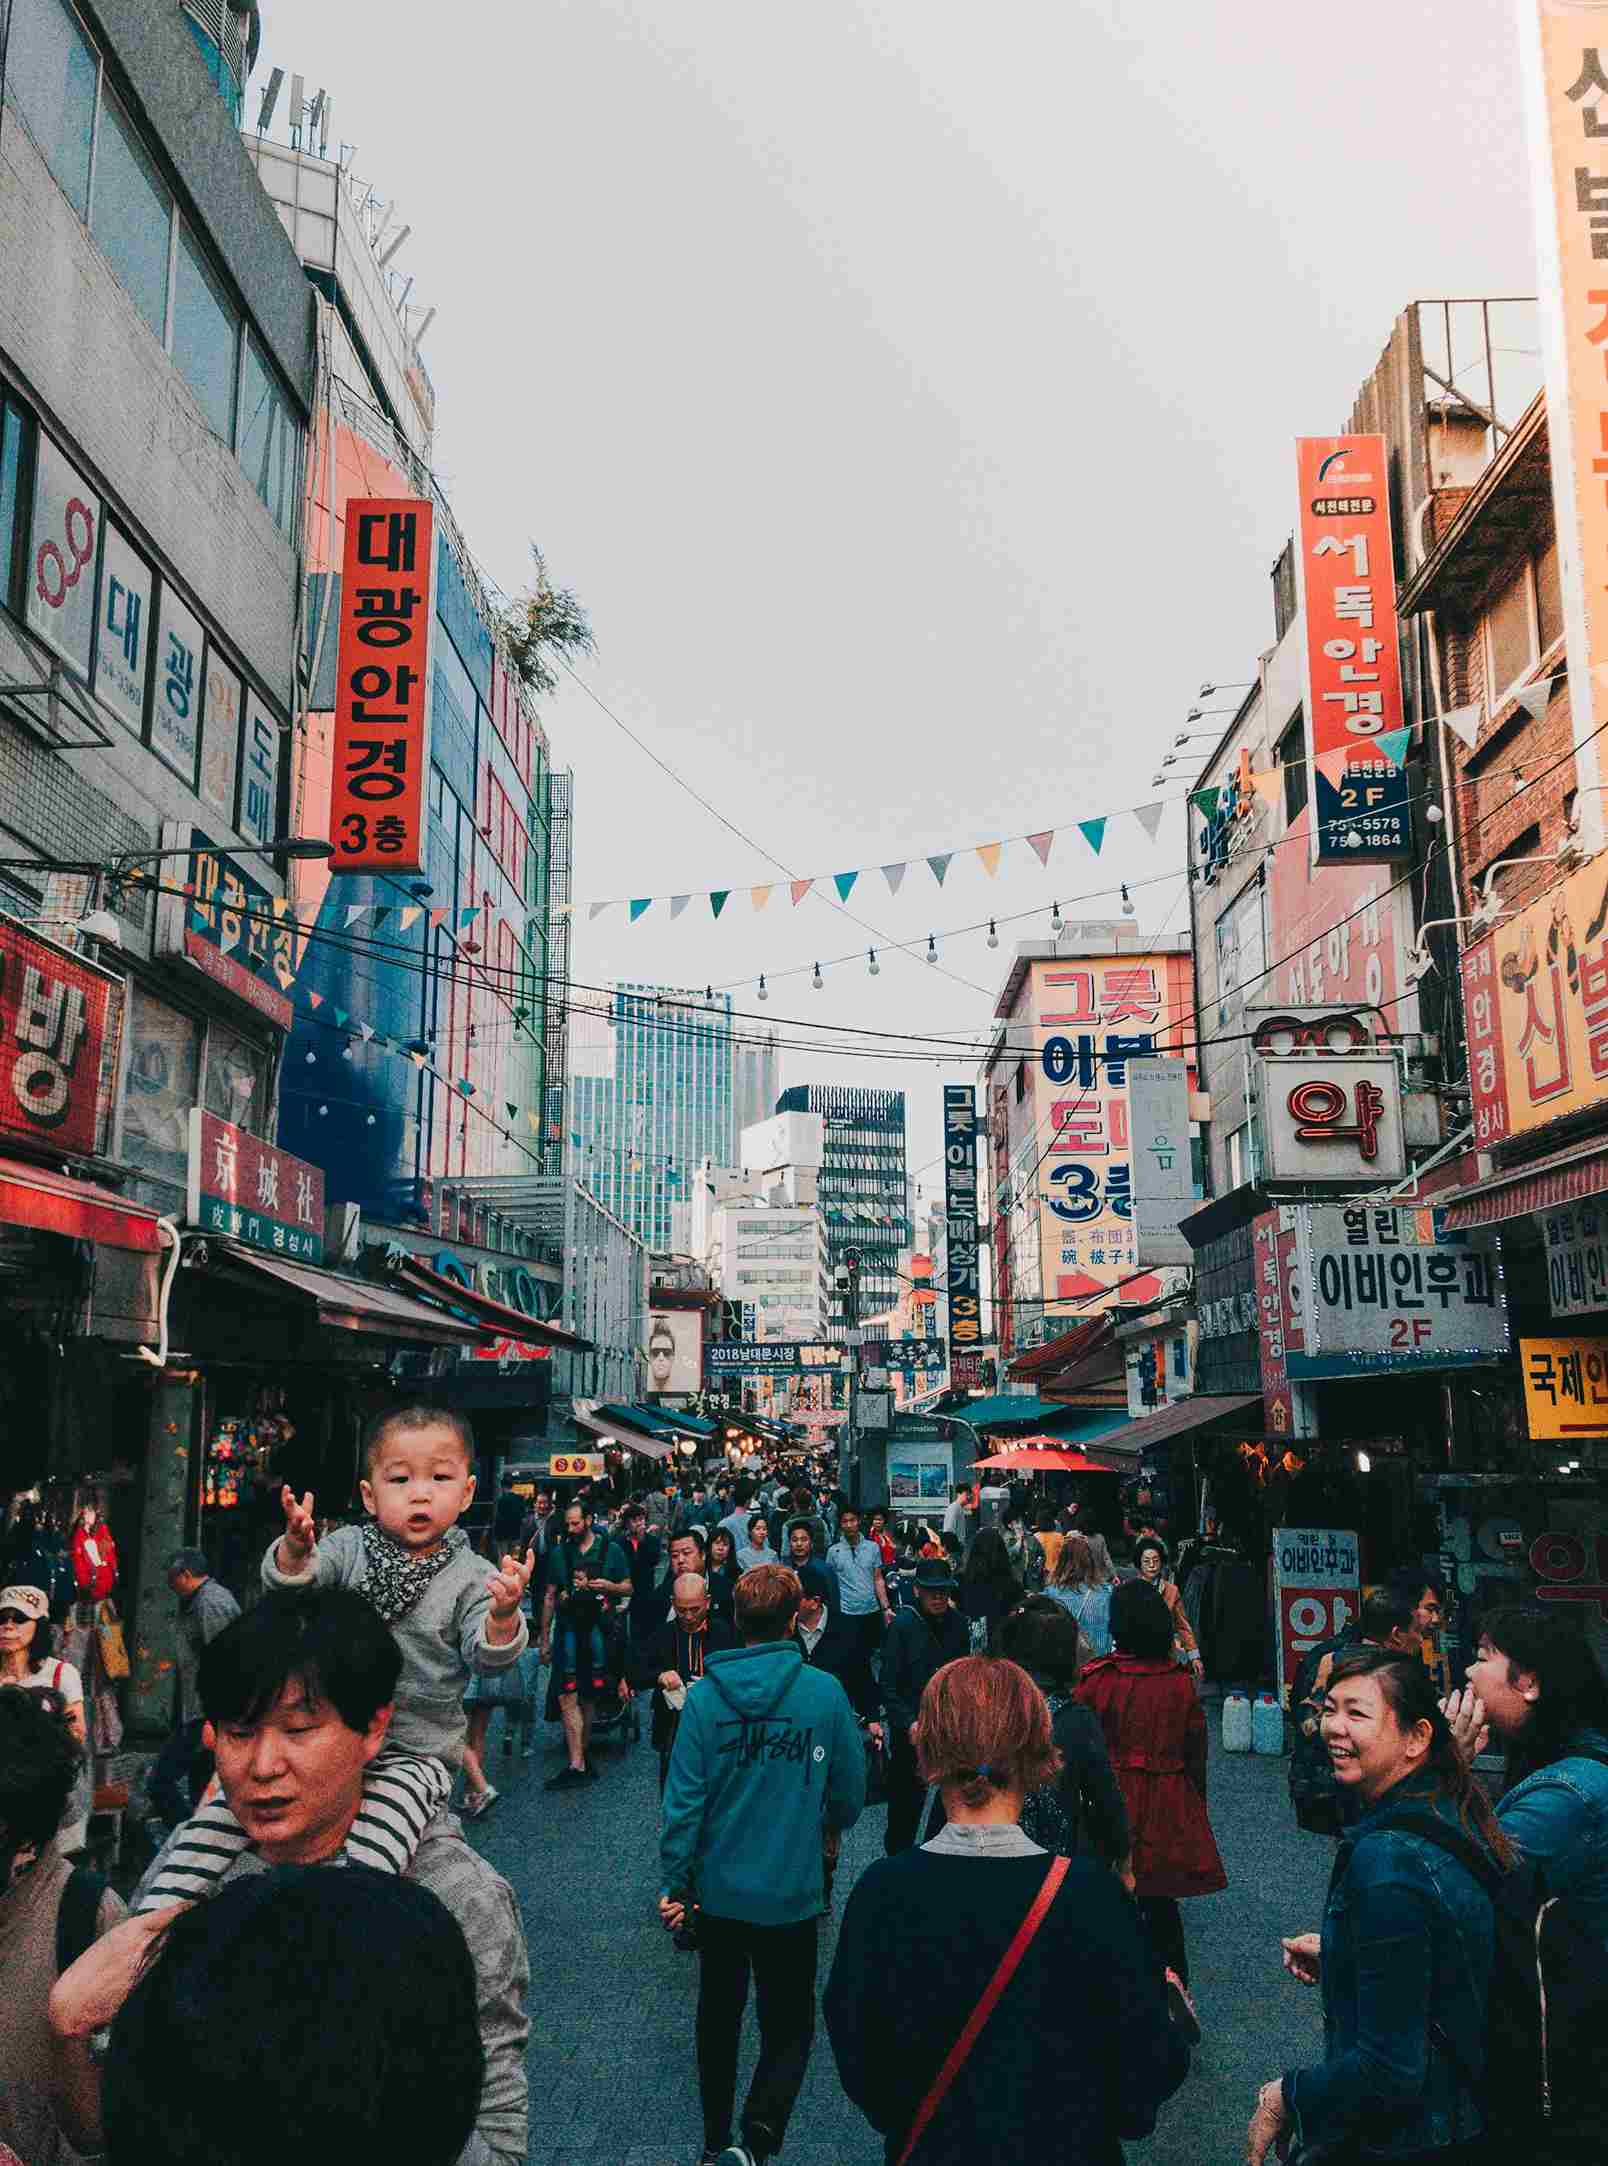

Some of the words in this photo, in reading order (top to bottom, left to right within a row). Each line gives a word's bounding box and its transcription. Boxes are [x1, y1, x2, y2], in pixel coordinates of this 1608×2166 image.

[1312, 534, 1385, 736] 서독안경
[345, 512, 421, 801] 대광안경
[340, 815, 407, 854] 3층
[1328, 834, 1401, 848] 75-1864
[1040, 969, 1161, 1025] 그릇
[1288, 1080, 1385, 1160] 약
[1343, 1207, 1400, 1245] 열린
[1319, 1252, 1495, 1309] 이비인후과
[1390, 1318, 1432, 1347] 2F
[711, 1347, 795, 1361] 2018남대문시장
[709, 1393, 730, 1409] 안경
